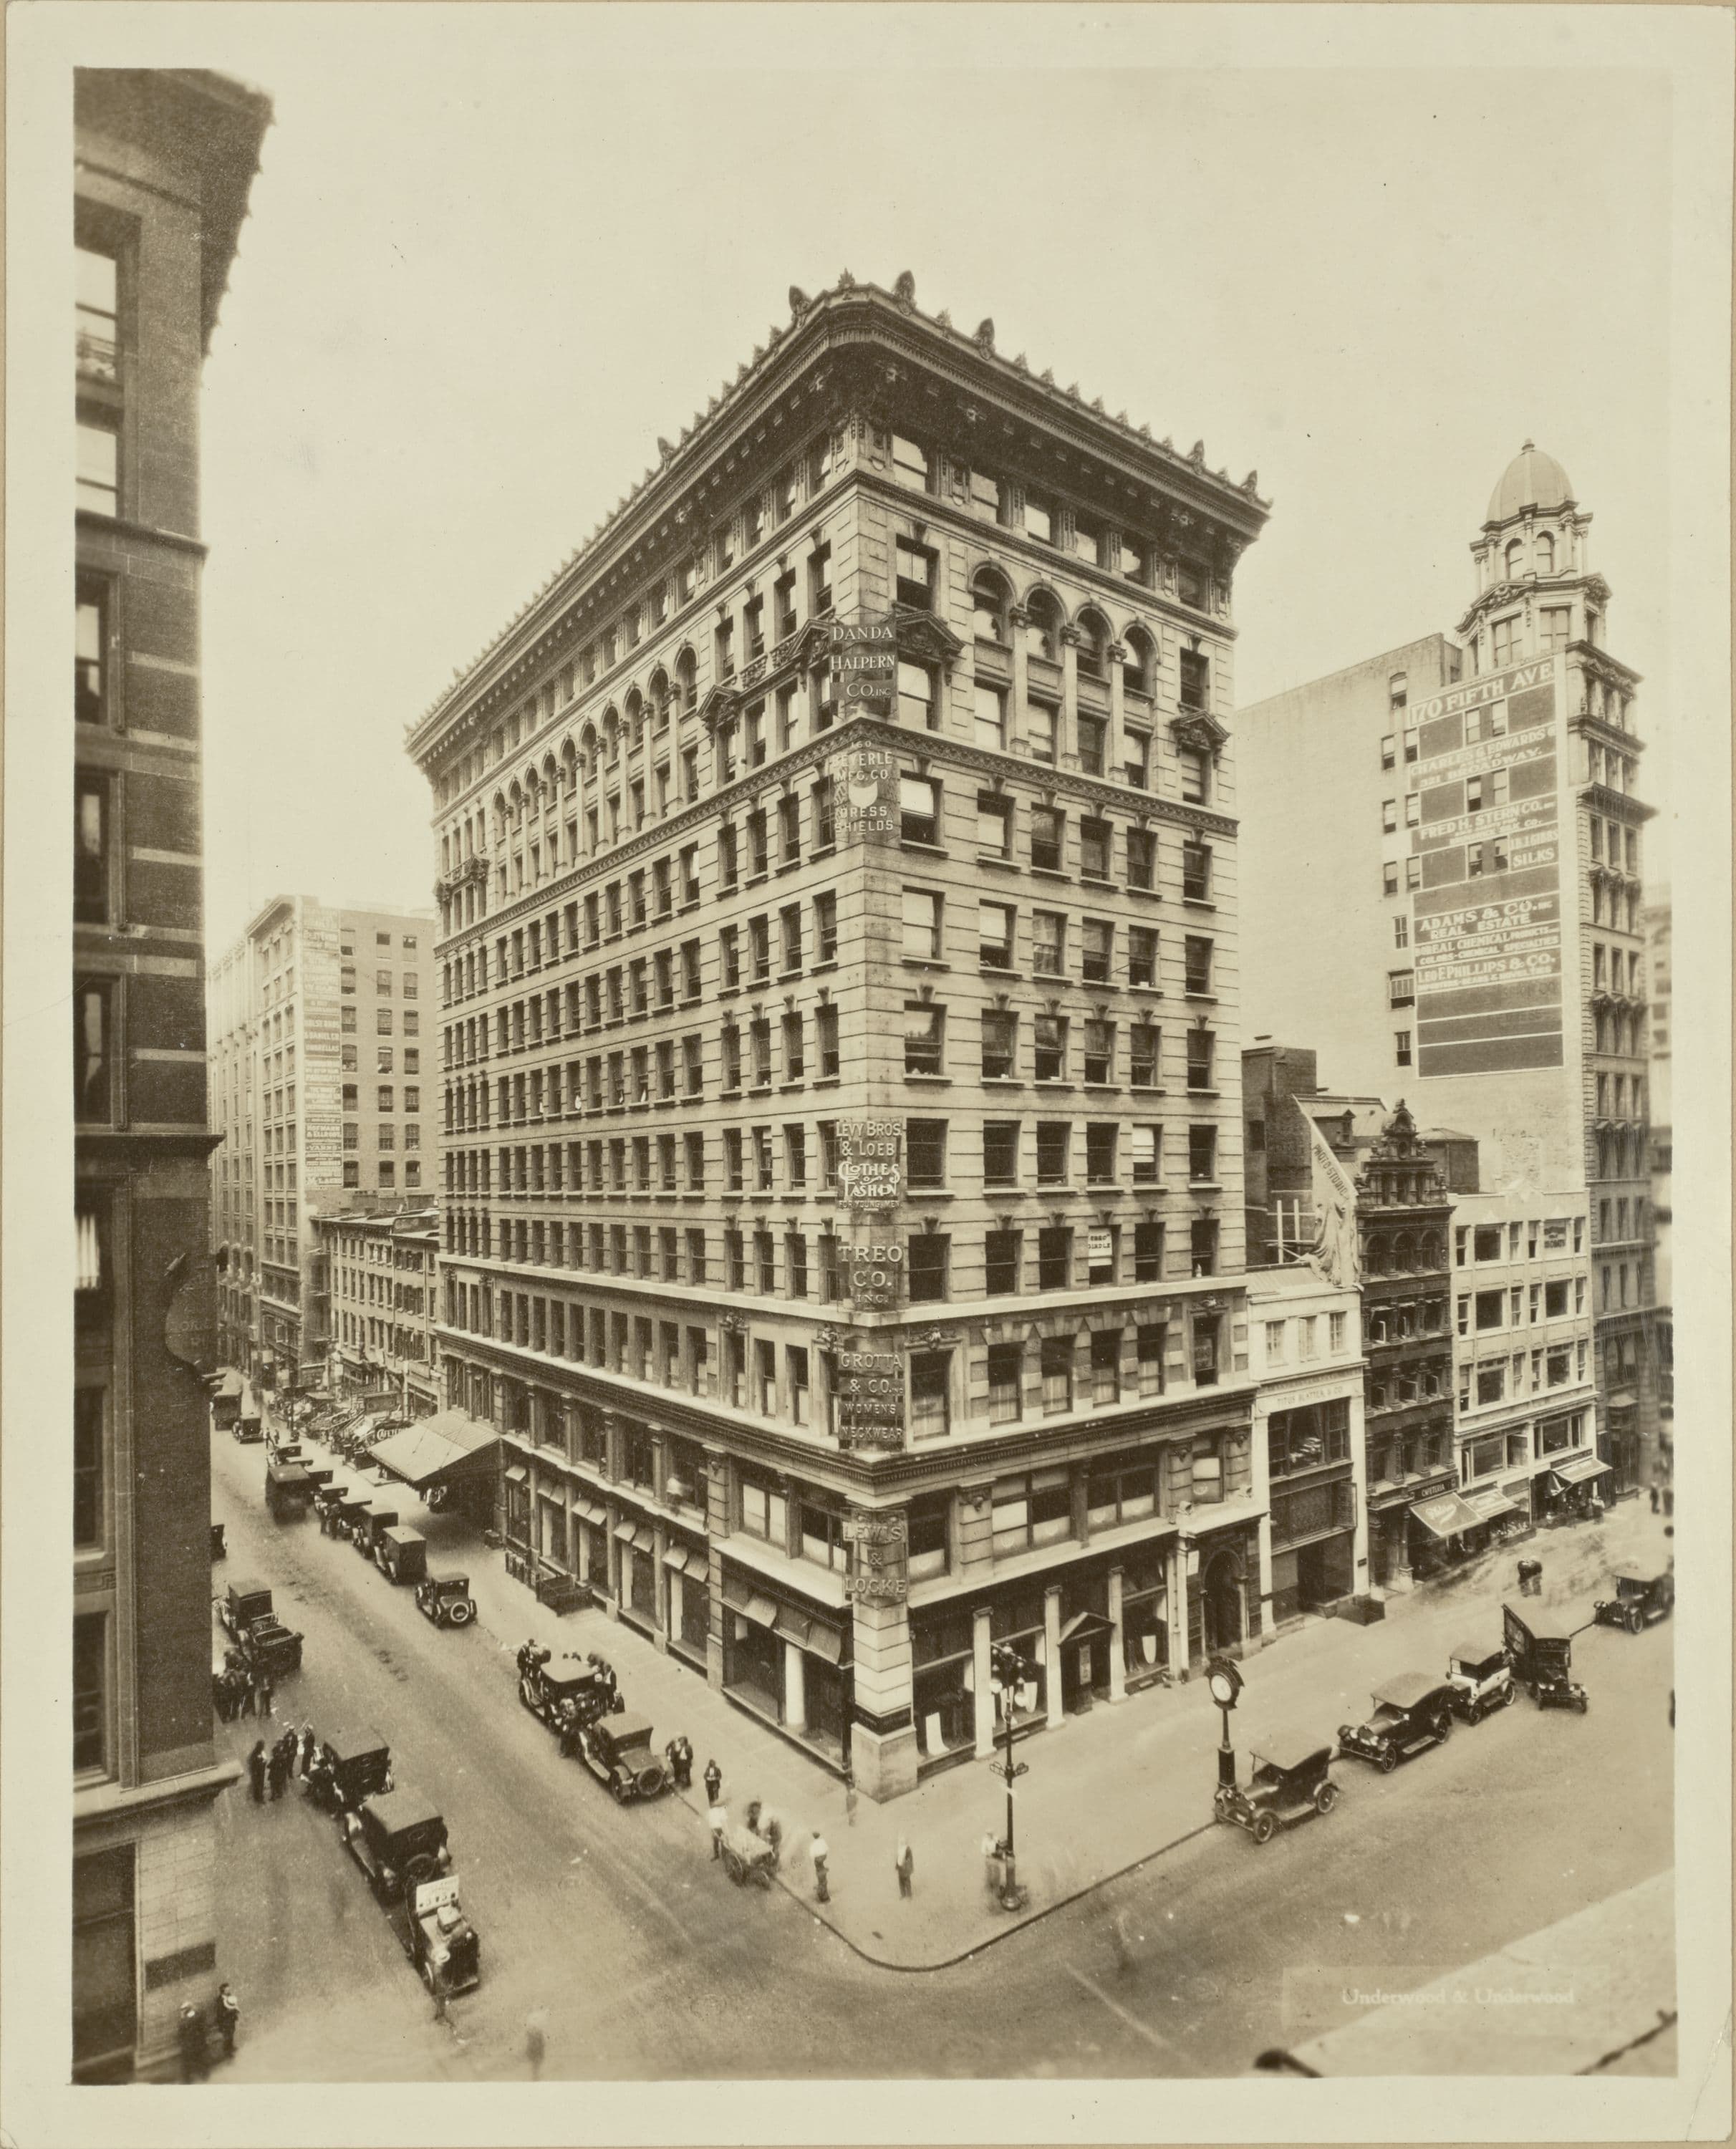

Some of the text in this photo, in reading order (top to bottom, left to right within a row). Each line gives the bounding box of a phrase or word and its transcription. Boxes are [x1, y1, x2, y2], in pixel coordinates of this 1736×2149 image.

[833, 626, 893, 642] DANDA
[831, 655, 895, 671] HALPERN
[1411, 698, 1442, 725] 170
[1447, 678, 1504, 712] FIFTH
[851, 740, 872, 748] 160
[1411, 749, 1474, 776] CHARLES
[1487, 727, 1545, 755] EDWARDS
[840, 806, 887, 818] DRESS
[834, 819, 894, 832] SHIELDS
[1420, 821, 1457, 840] FRED
[1475, 804, 1519, 826] STERN
[1513, 847, 1555, 868] SILKS
[1419, 910, 1478, 932] ADAMS
[1481, 907, 1500, 919] &
[1430, 912, 1532, 940] REAL ESTATE
[1457, 932, 1510, 950] CHEMICAL
[1447, 959, 1506, 979] PHILLIPS
[1509, 957, 1525, 970] &
[836, 1121, 864, 1137] LEVY
[842, 1141, 894, 1156] & LOEB
[838, 1161, 900, 1184] CLOTHES
[844, 1180, 897, 1197] FASHION
[838, 1246, 903, 1262] TREO
[852, 1270, 892, 1287] CO.
[840, 1353, 902, 1369] GROTTA
[849, 1378, 861, 1393] &
[842, 1426, 903, 1439] NECKWEAR
[869, 1552, 883, 1566] &
[845, 1578, 906, 1593] LOCKE
